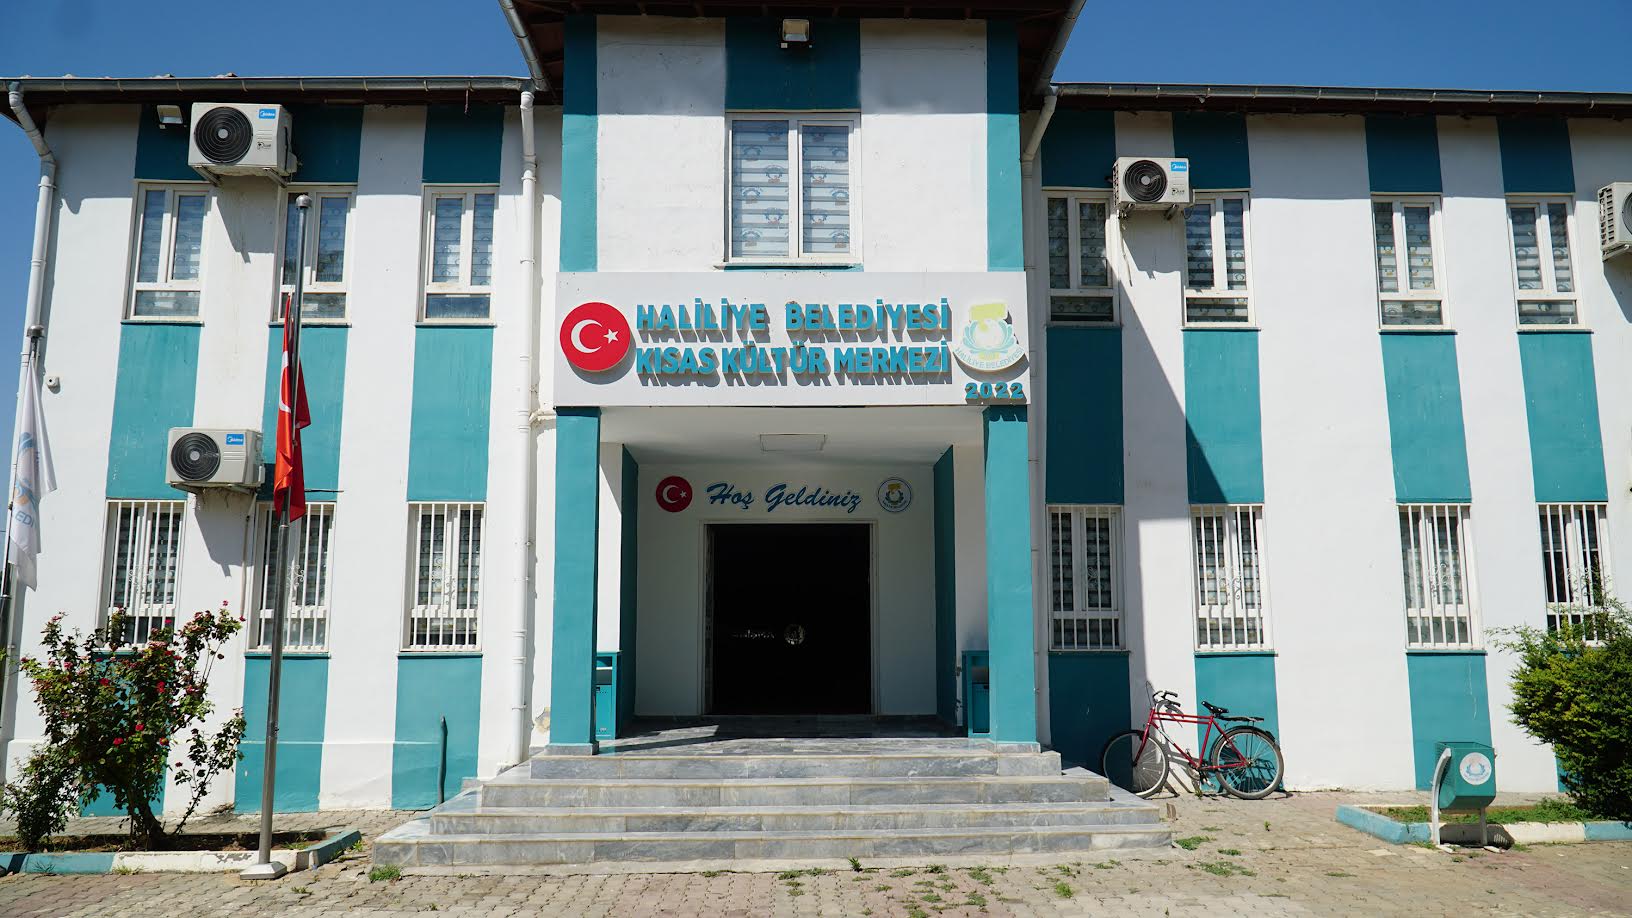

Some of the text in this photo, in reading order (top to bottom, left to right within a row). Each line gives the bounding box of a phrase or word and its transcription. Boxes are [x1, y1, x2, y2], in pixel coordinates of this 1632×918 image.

[636, 298, 948, 330] HALİLİYE BELEDİYESİ
[636, 340, 948, 374] KISAS KÜLTÜR MERKEZİ
[965, 381, 1024, 400] 2022
[706, 482, 862, 514] Hoş Geldiniz
